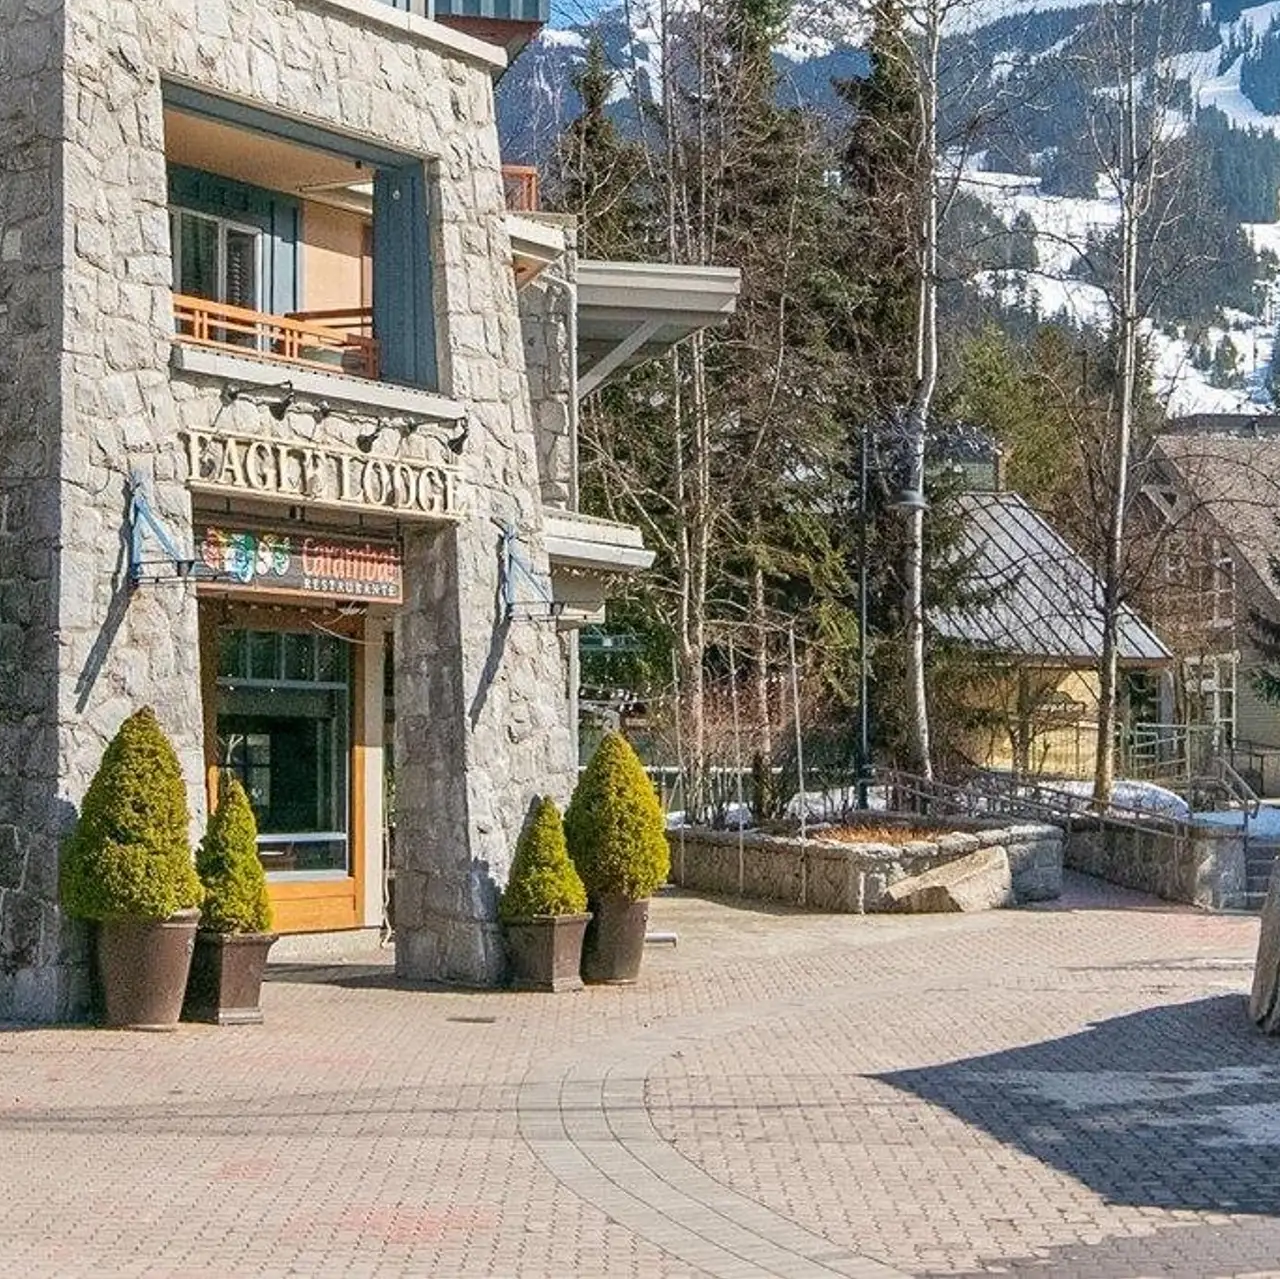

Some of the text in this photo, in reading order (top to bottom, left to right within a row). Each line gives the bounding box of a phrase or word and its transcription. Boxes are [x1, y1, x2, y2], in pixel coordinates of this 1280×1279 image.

[189, 431, 468, 517] EAGLE LODGE
[304, 578, 398, 596] RESTAURANTE
